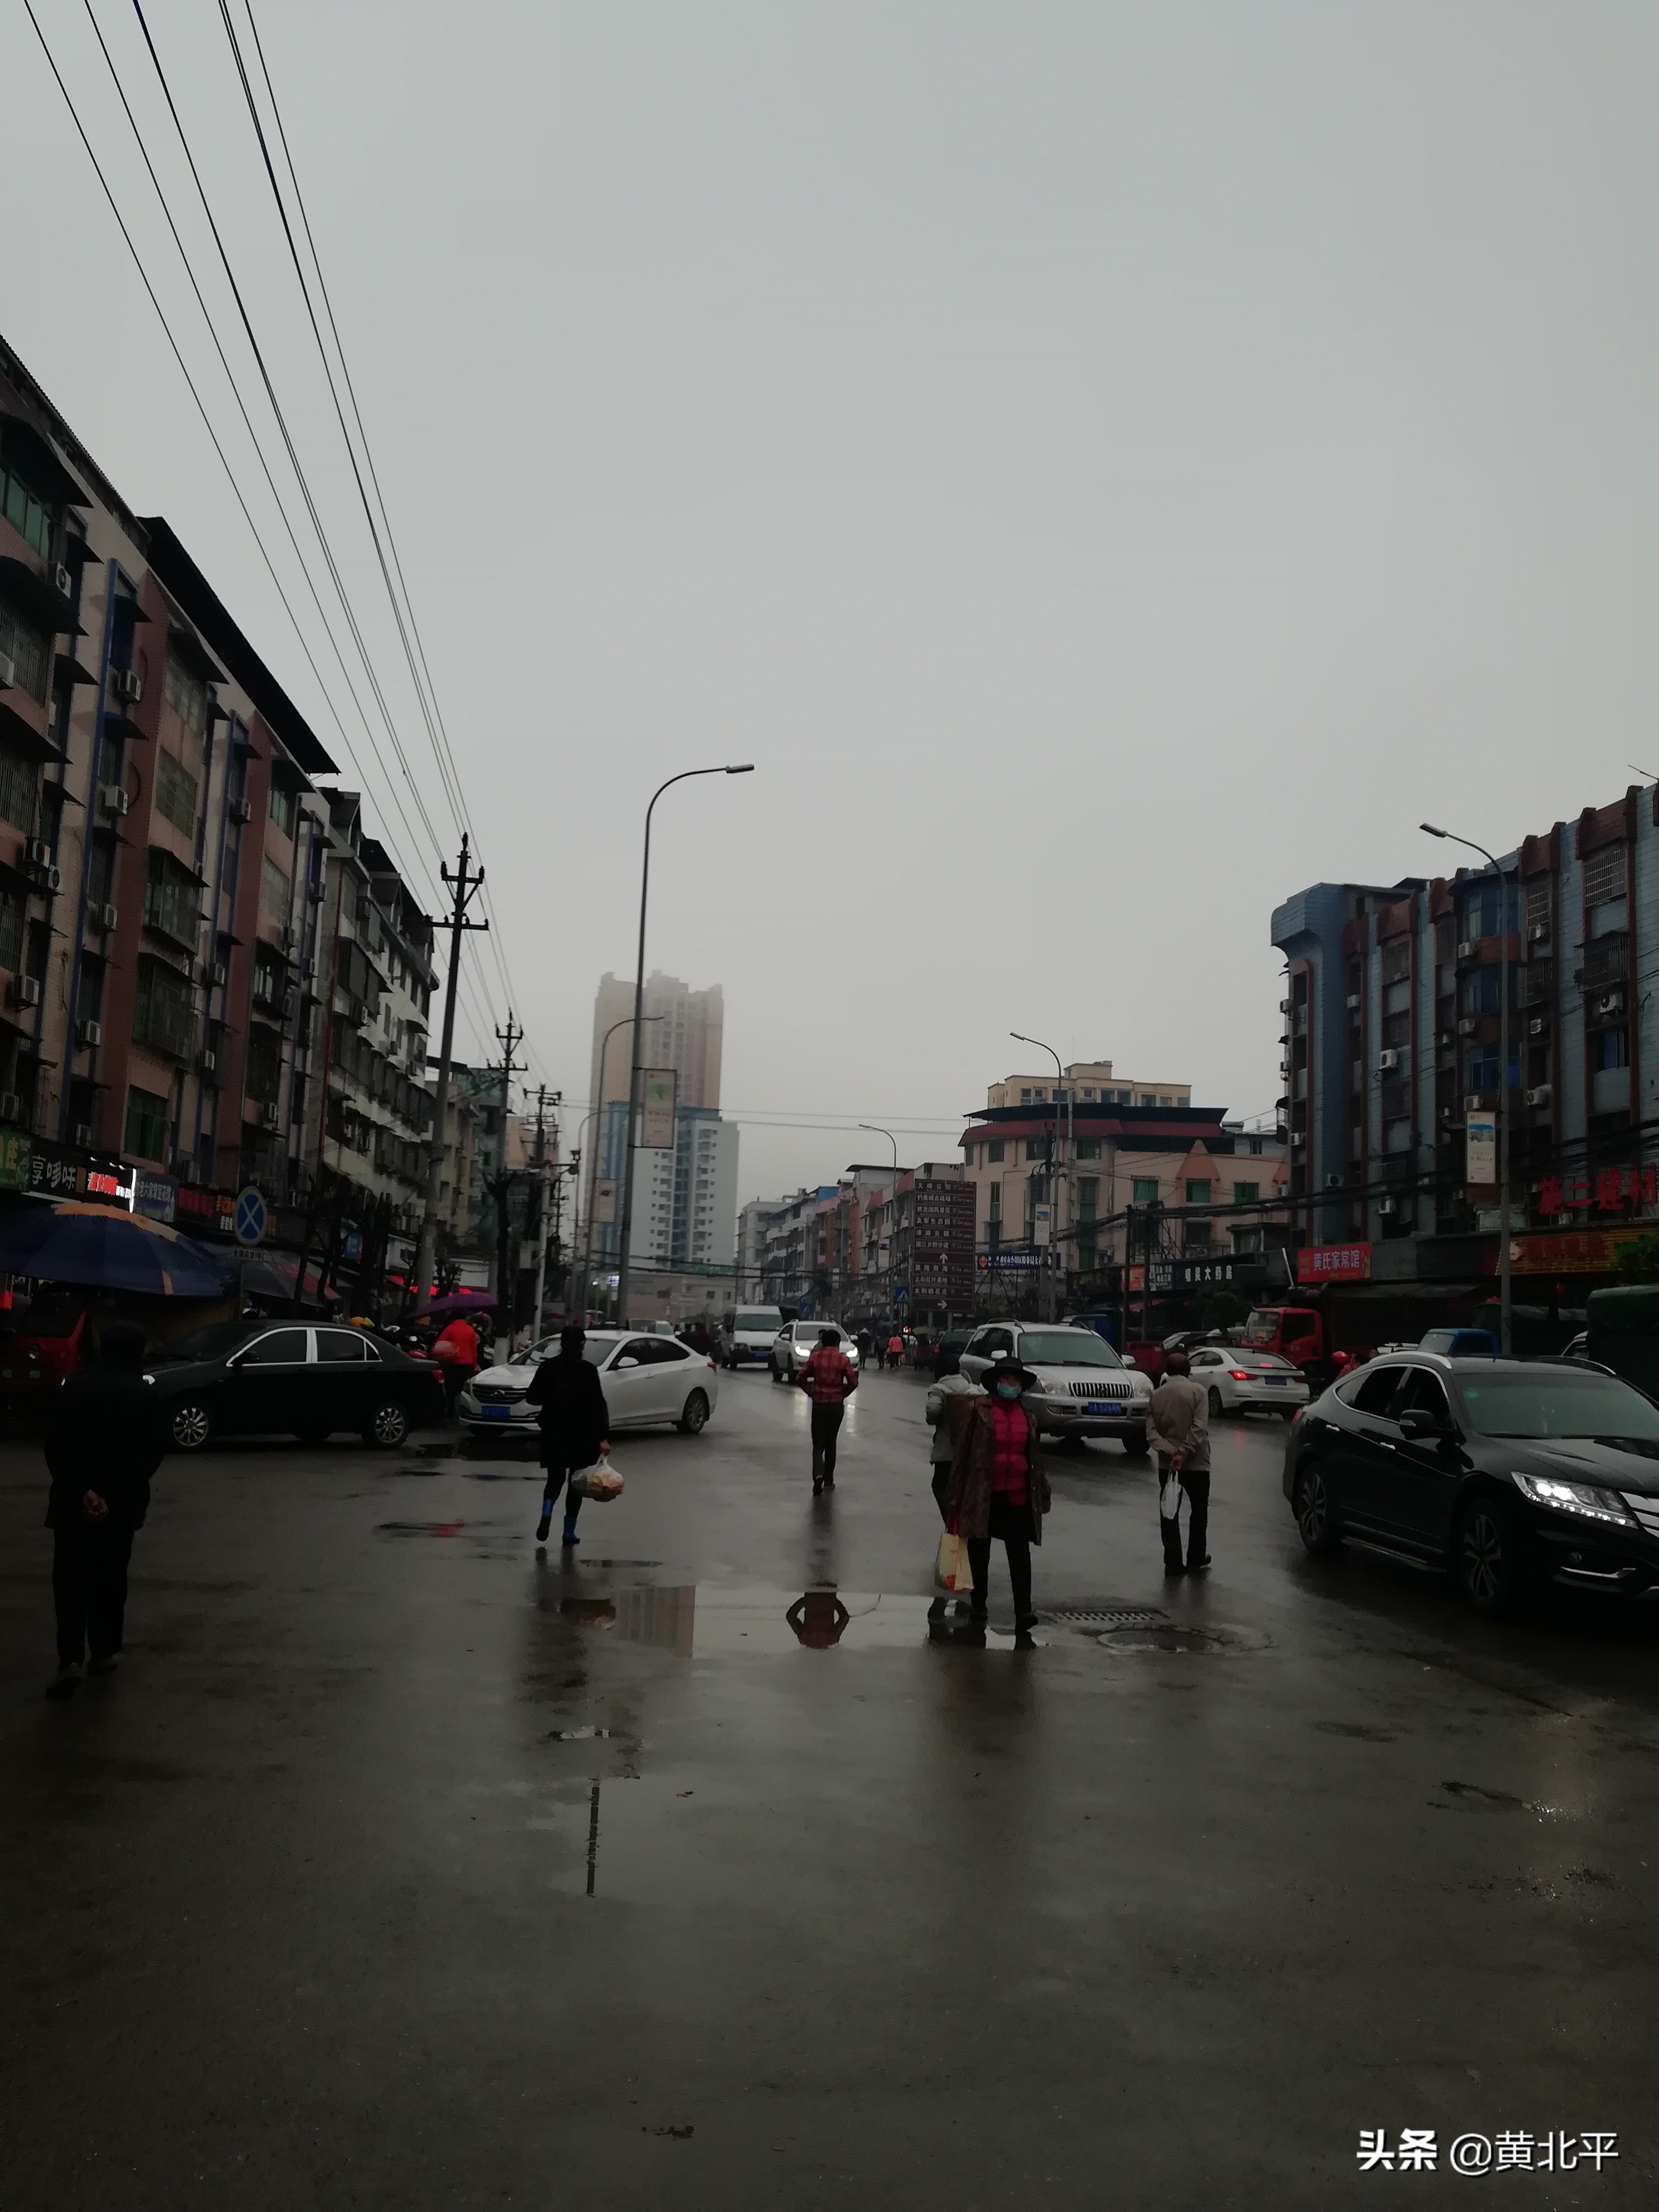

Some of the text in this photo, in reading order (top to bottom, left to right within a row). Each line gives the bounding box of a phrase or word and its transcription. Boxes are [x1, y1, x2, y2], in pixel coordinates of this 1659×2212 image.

[1313, 1249, 1360, 1271] 黄氏家常馆
